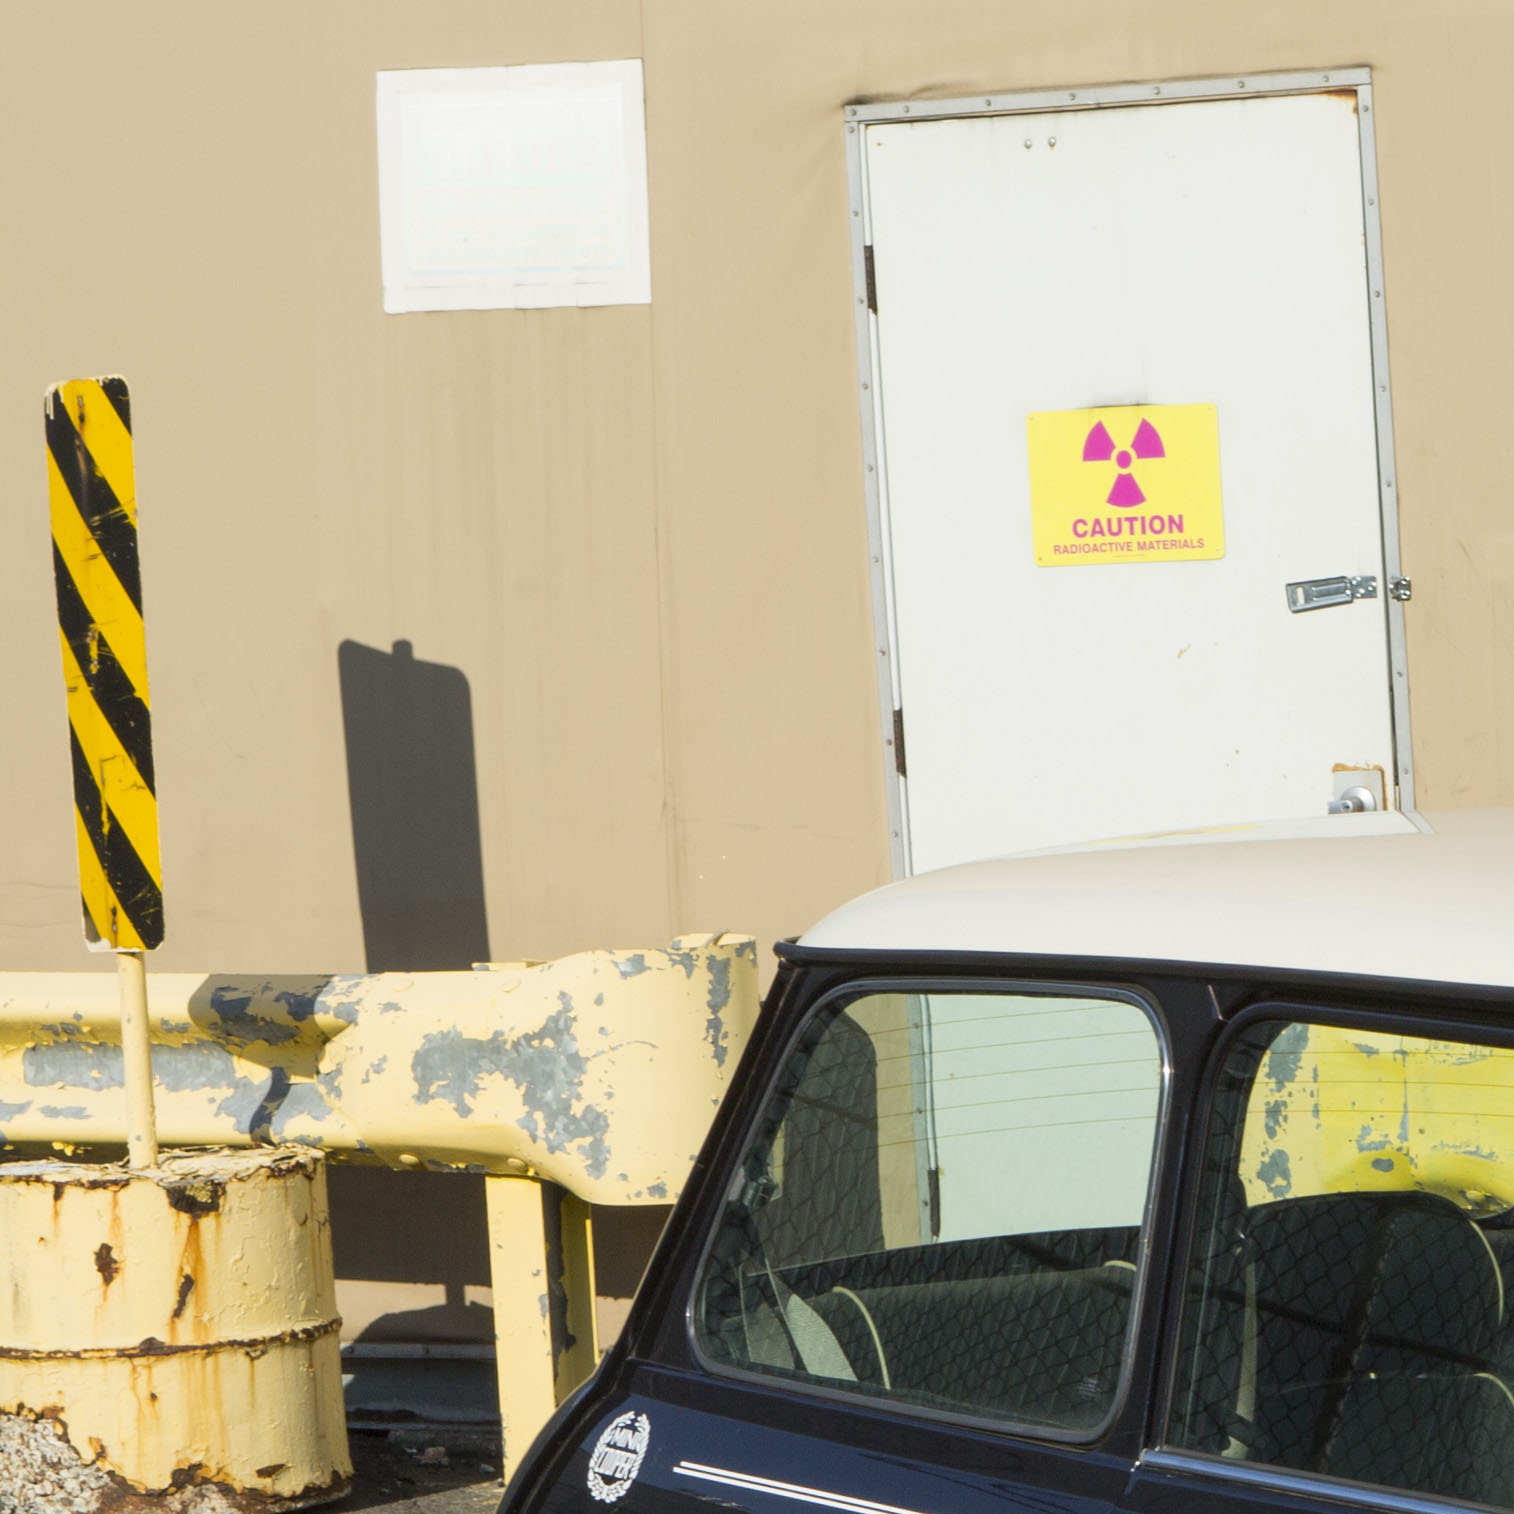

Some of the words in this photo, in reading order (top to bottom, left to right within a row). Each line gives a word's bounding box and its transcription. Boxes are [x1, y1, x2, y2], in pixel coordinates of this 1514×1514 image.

[1072, 514, 1184, 538] CAUTION
[1053, 541, 1133, 555] RADIOACTIVE
[1137, 538, 1205, 551] MATERIALS
[610, 1426, 641, 1453] MINI
[594, 1447, 638, 1480] COOPER
